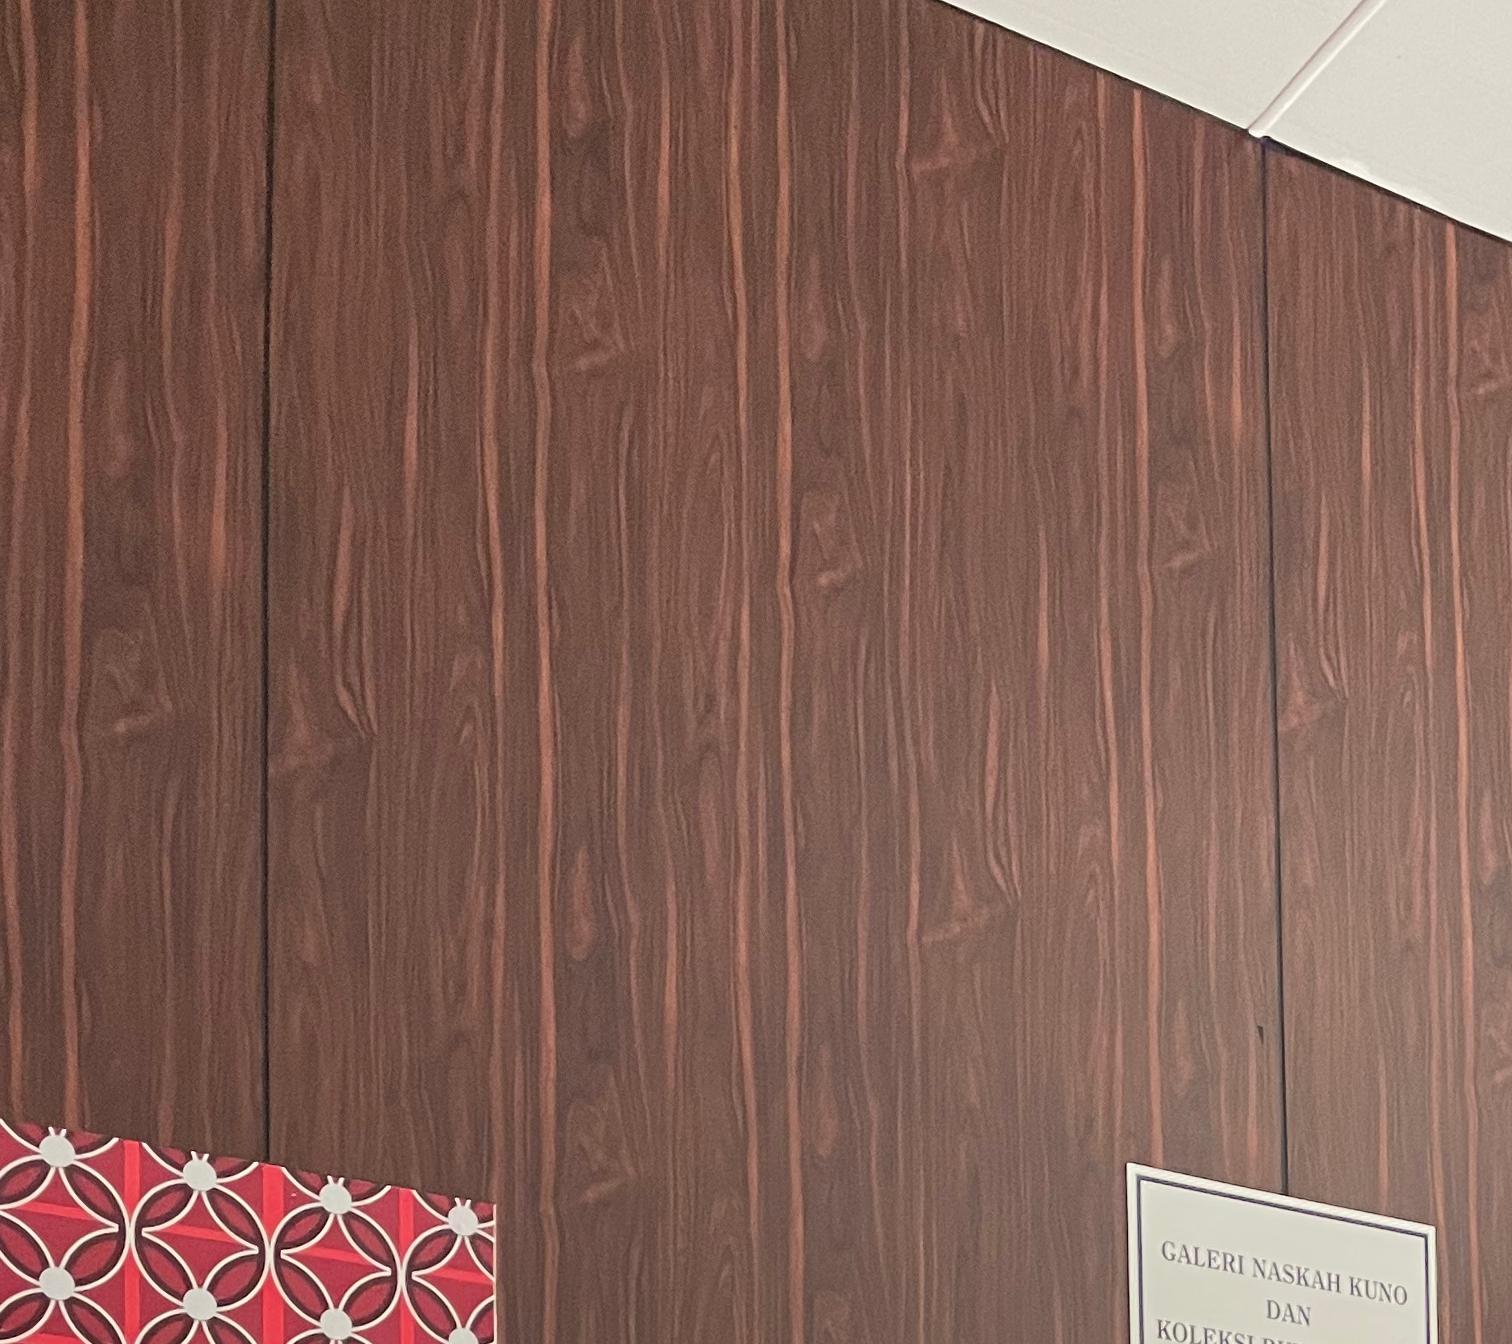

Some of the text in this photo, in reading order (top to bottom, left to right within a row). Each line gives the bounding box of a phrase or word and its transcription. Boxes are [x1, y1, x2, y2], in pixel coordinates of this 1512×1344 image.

[1161, 1240, 1408, 1306] GALERI NASKAH KUNO
[1266, 1299, 1311, 1327] DAN
